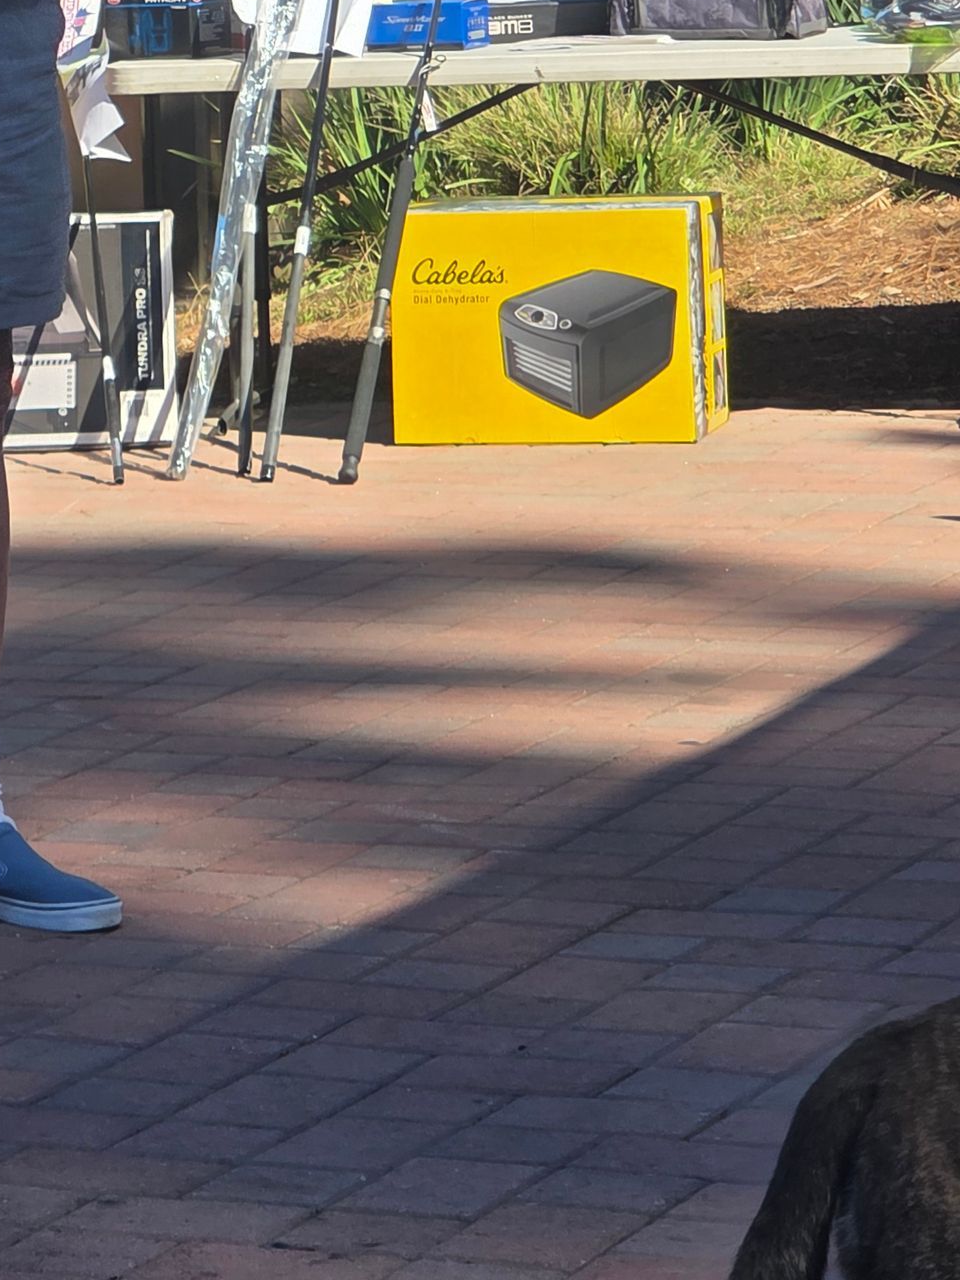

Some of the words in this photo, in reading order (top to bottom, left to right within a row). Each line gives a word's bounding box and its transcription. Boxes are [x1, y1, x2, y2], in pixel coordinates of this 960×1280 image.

[135, 287, 147, 319] PRO
[413, 295, 432, 305] Dial
[435, 294, 490, 306] Dehydrator
[137, 320, 149, 381] TUNDRA
